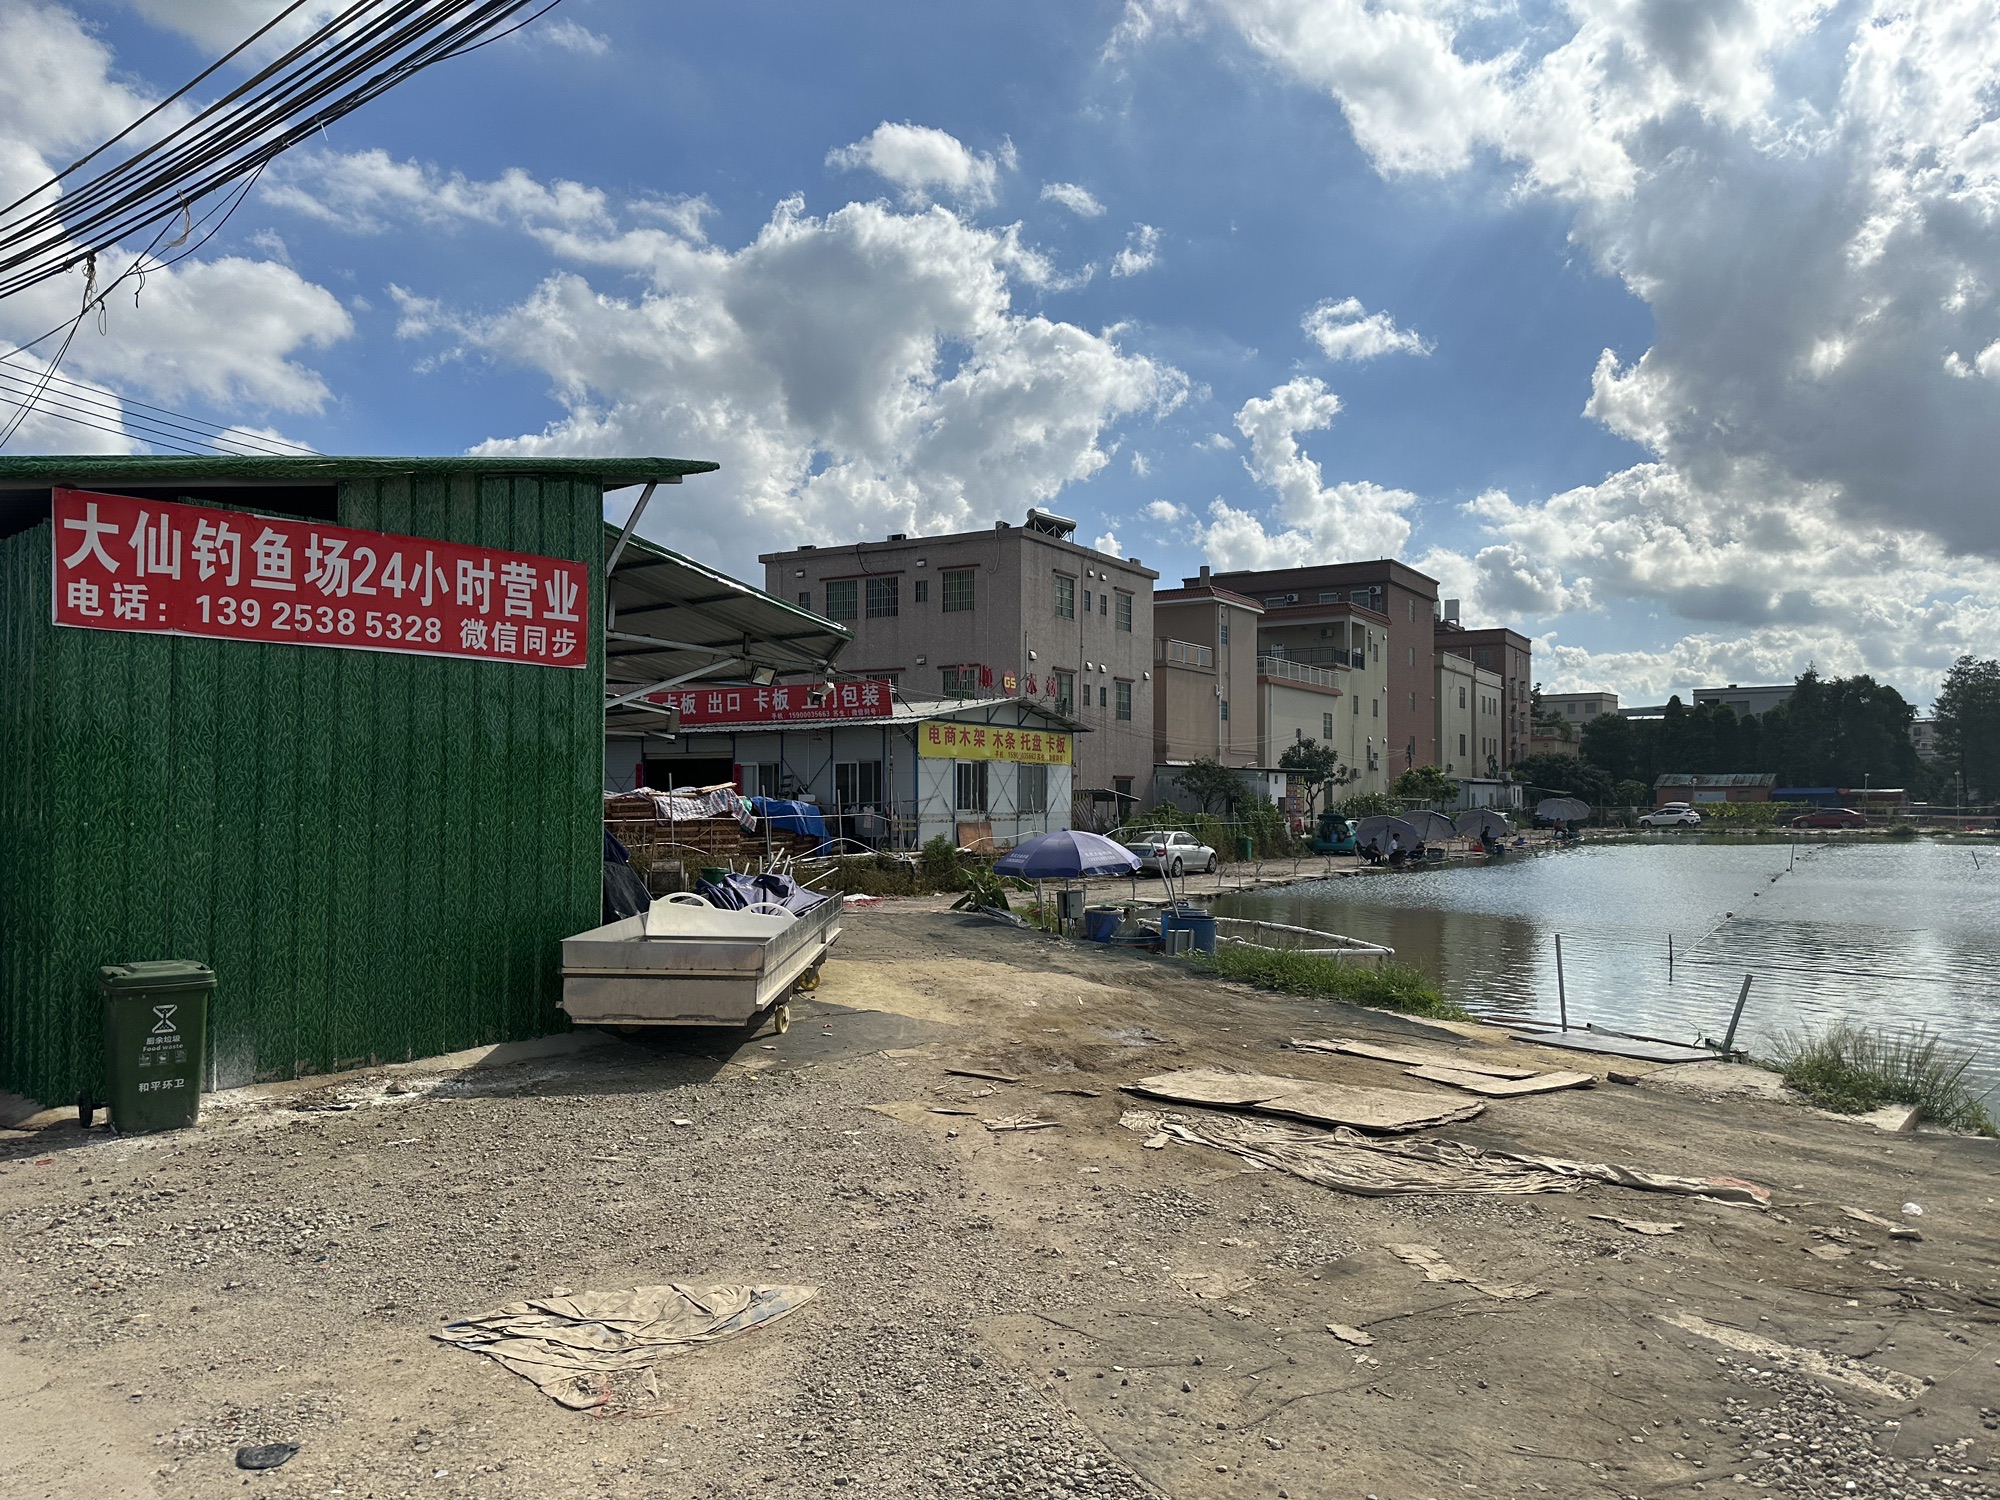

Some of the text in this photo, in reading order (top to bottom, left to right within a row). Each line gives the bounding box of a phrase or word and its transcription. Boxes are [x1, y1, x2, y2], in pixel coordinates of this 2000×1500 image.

[63, 502, 579, 622] 大仙钓鱼场24小时营业
[67, 578, 578, 658] 电话： 139 2538 5328 微信同步
[1004, 676, 1017, 689] GS
[708, 691, 741, 714] 出口
[753, 688, 790, 713] 卡板
[789, 710, 830, 719] 15900035663
[929, 725, 1066, 754] 电商木架 木条 托盘 卡板
[138, 1079, 185, 1092] 和平环卫
